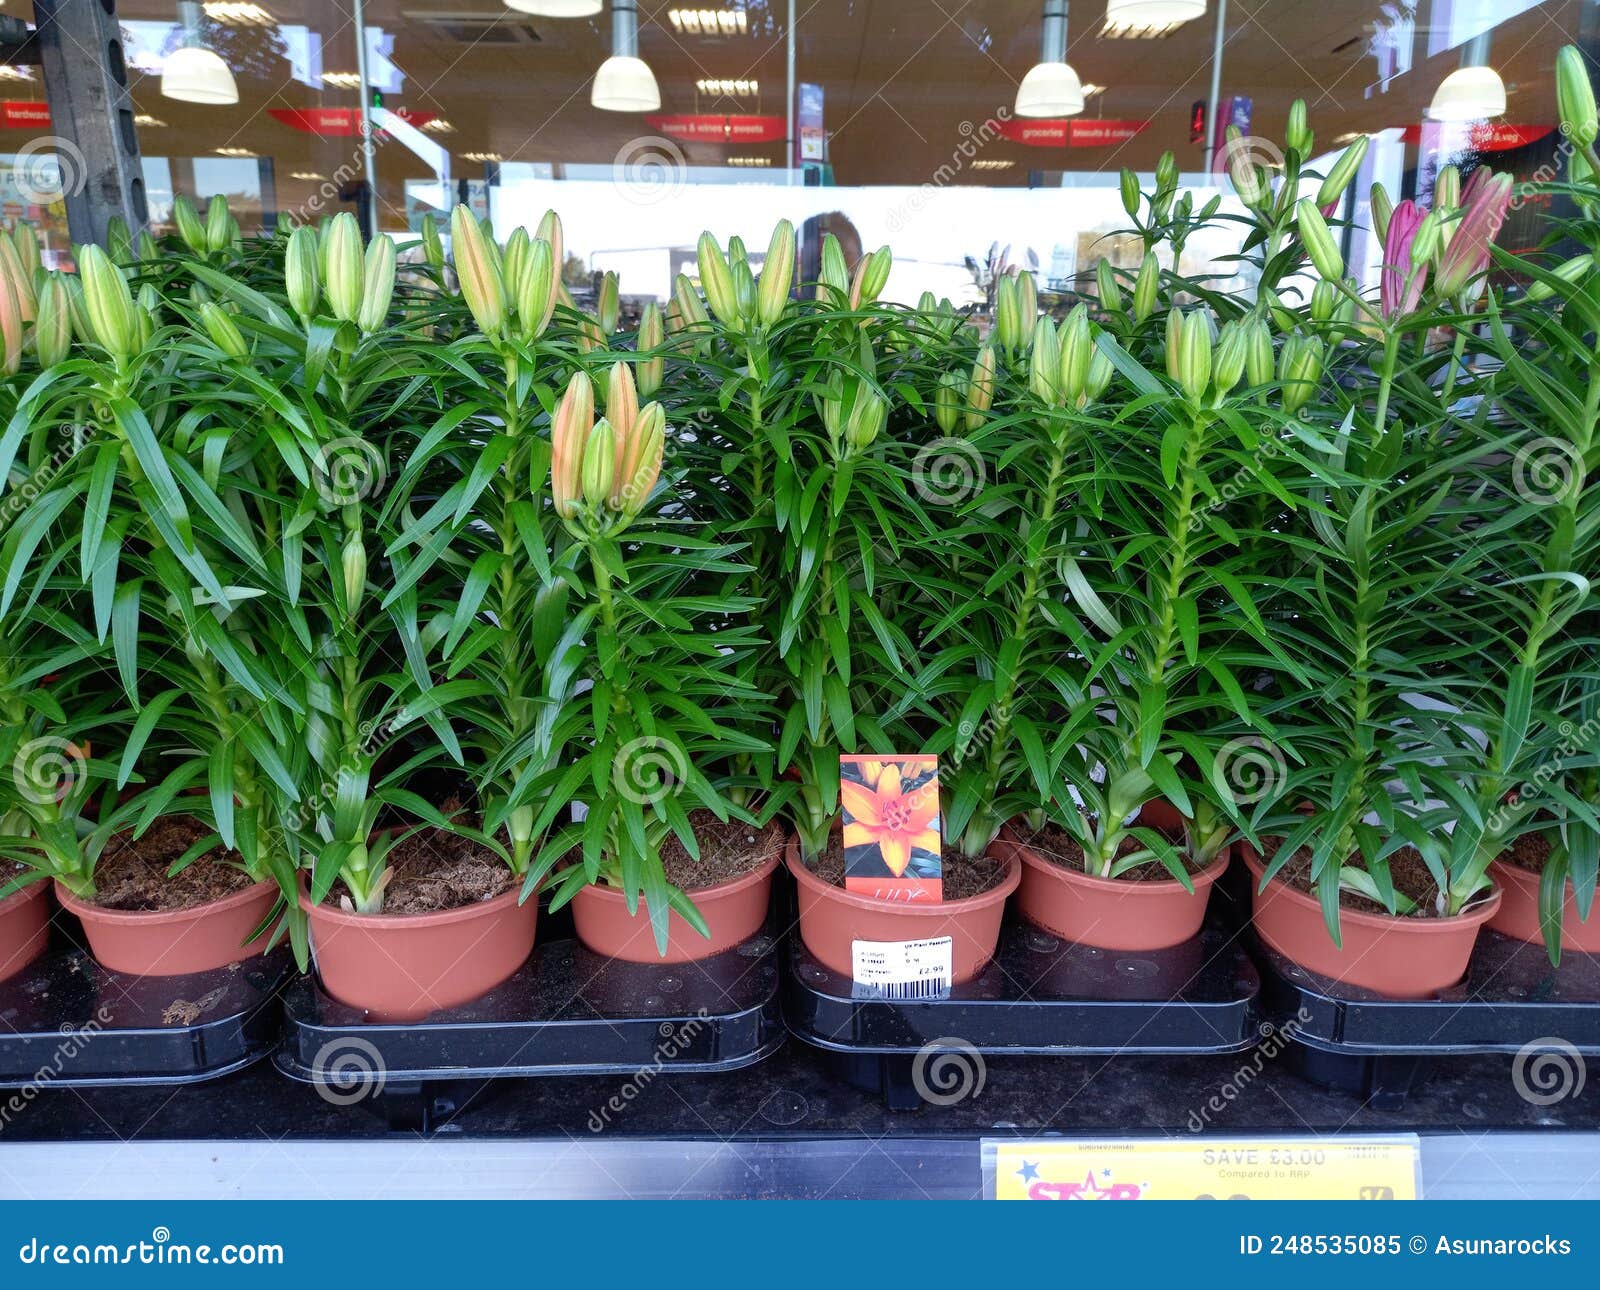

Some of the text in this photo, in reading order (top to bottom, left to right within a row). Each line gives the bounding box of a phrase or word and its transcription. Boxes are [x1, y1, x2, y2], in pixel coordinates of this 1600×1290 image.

[1023, 129, 1064, 140] groceries
[919, 965, 944, 975] £2.99
[1203, 1148, 1259, 1166] SAVE
[1269, 1148, 1326, 1166] £3.00
[1218, 1169, 1311, 1179] Compared to RRP
